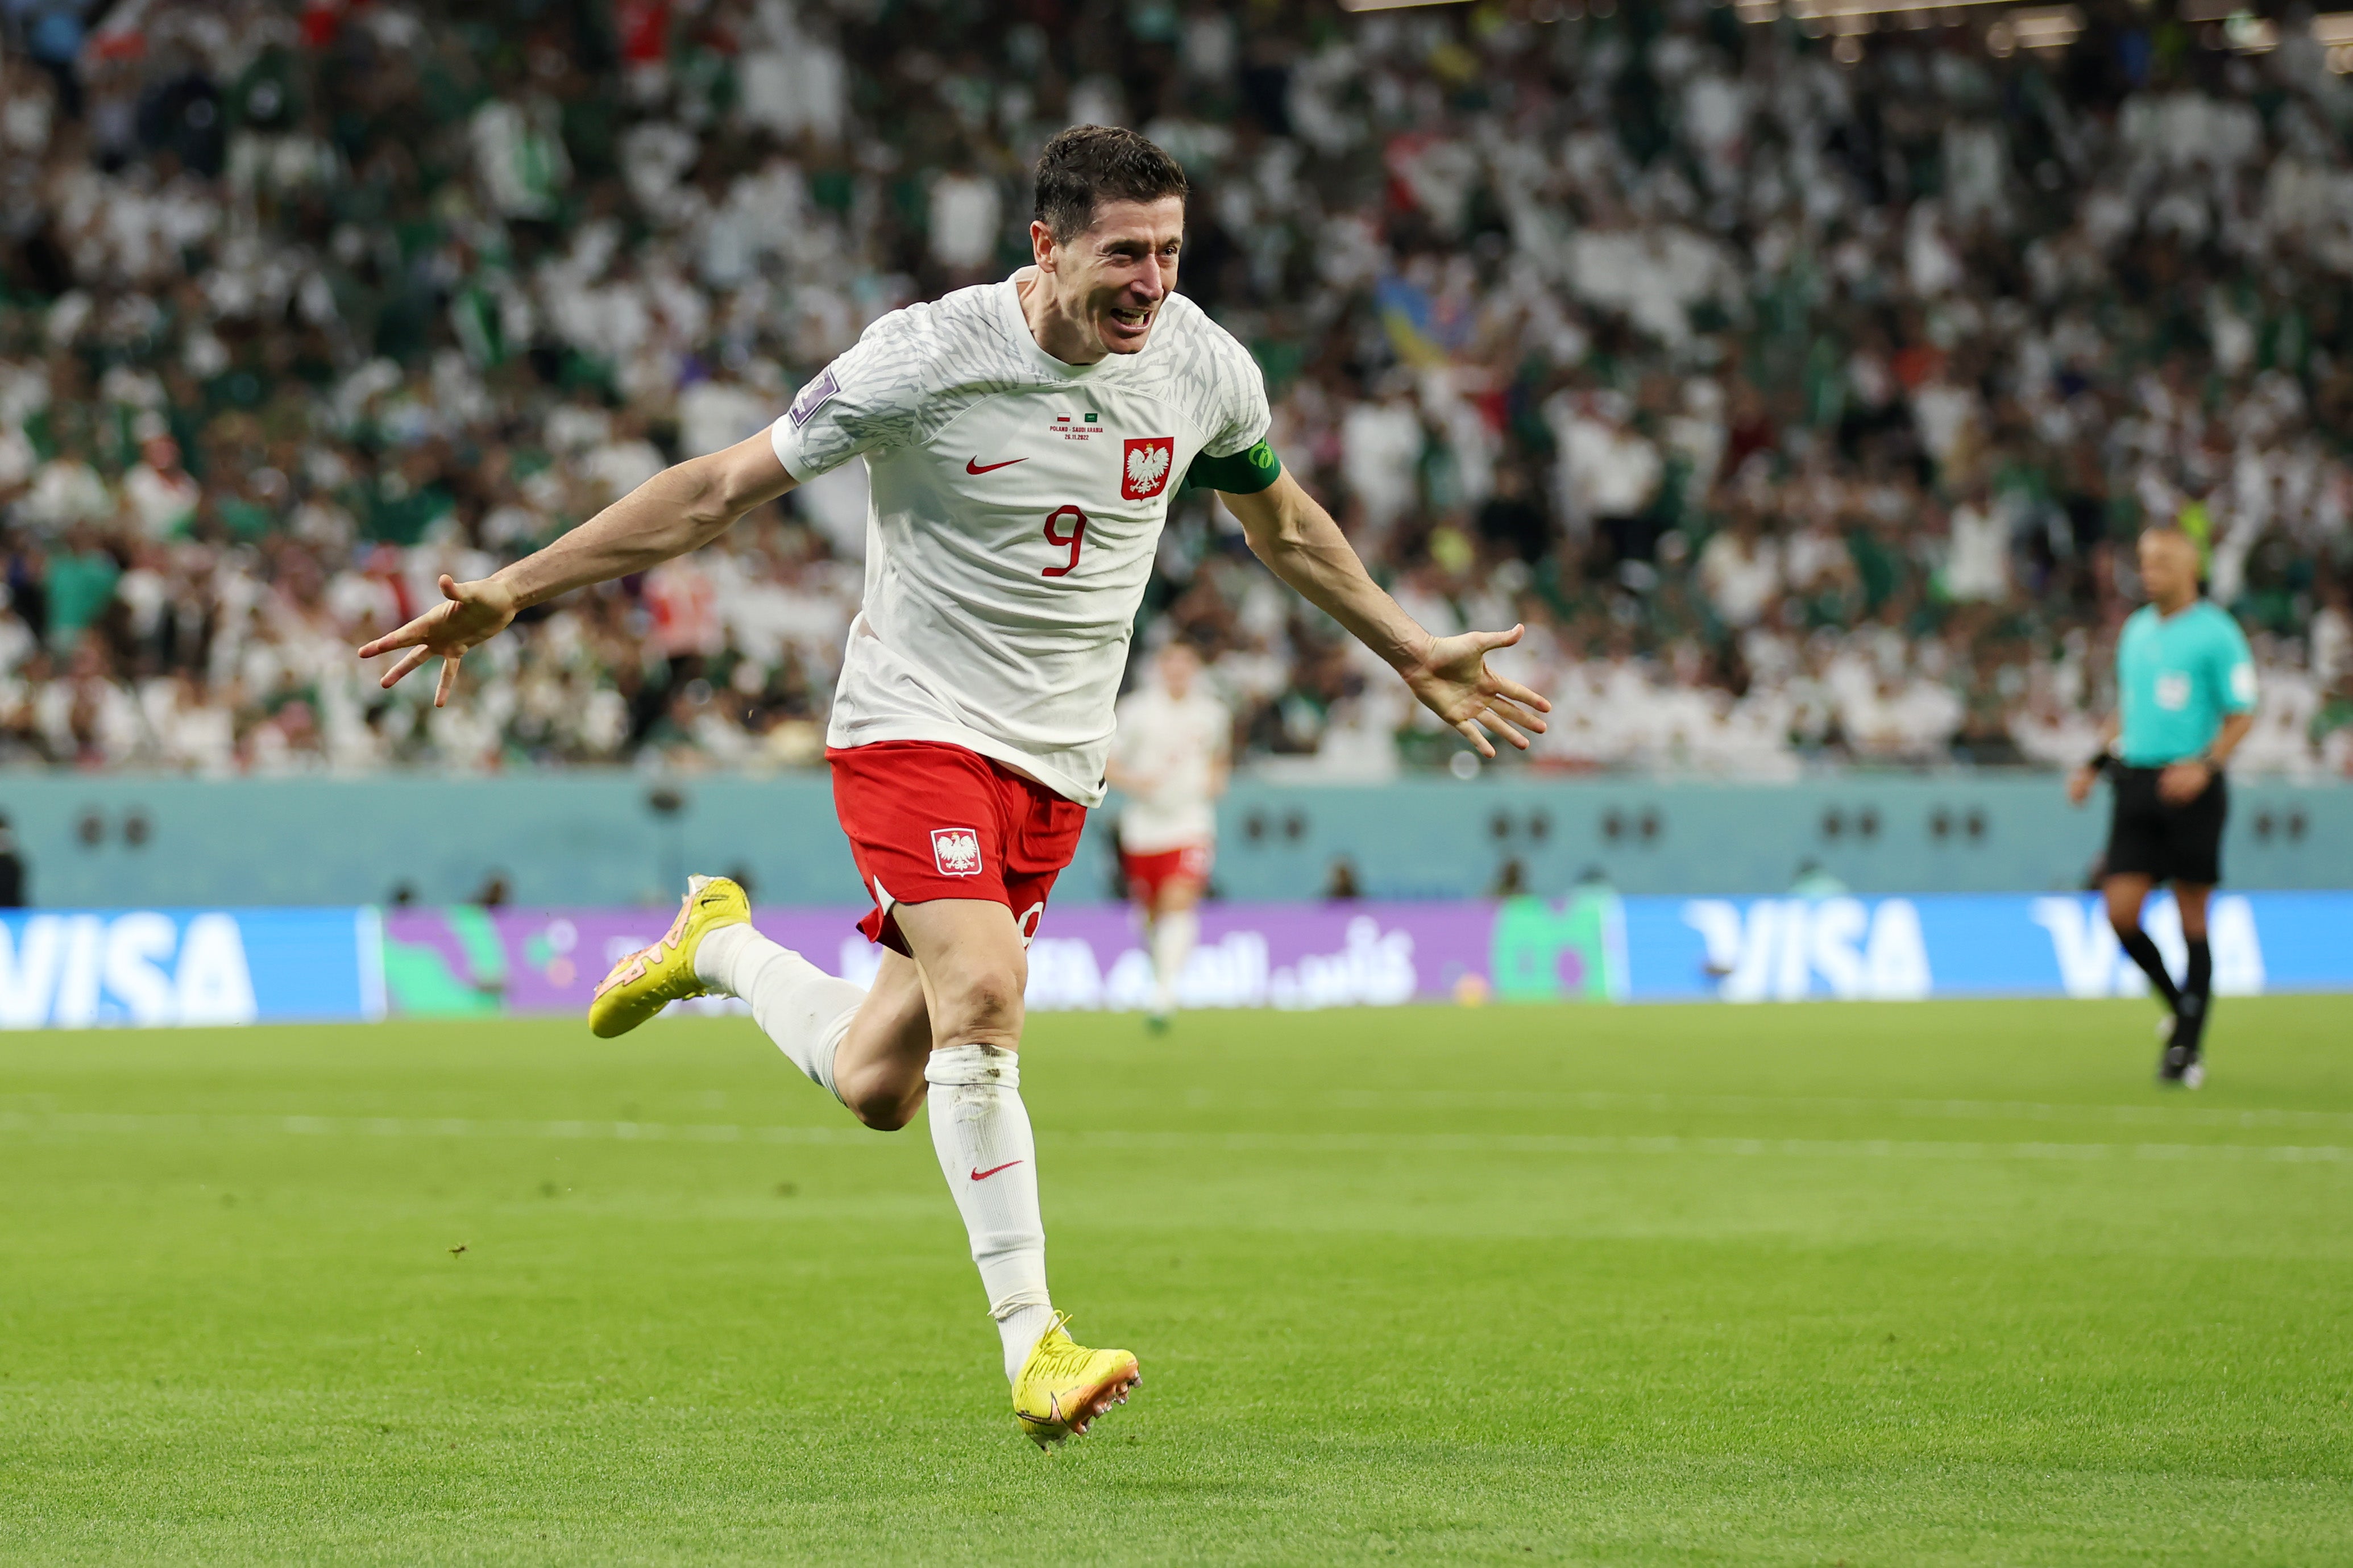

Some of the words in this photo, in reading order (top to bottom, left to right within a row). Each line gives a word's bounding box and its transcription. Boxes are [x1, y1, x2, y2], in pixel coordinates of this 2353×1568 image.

[1041, 505, 1088, 577] 9
[0, 912, 260, 1030] VISA
[1682, 898, 1932, 1002] VISA
